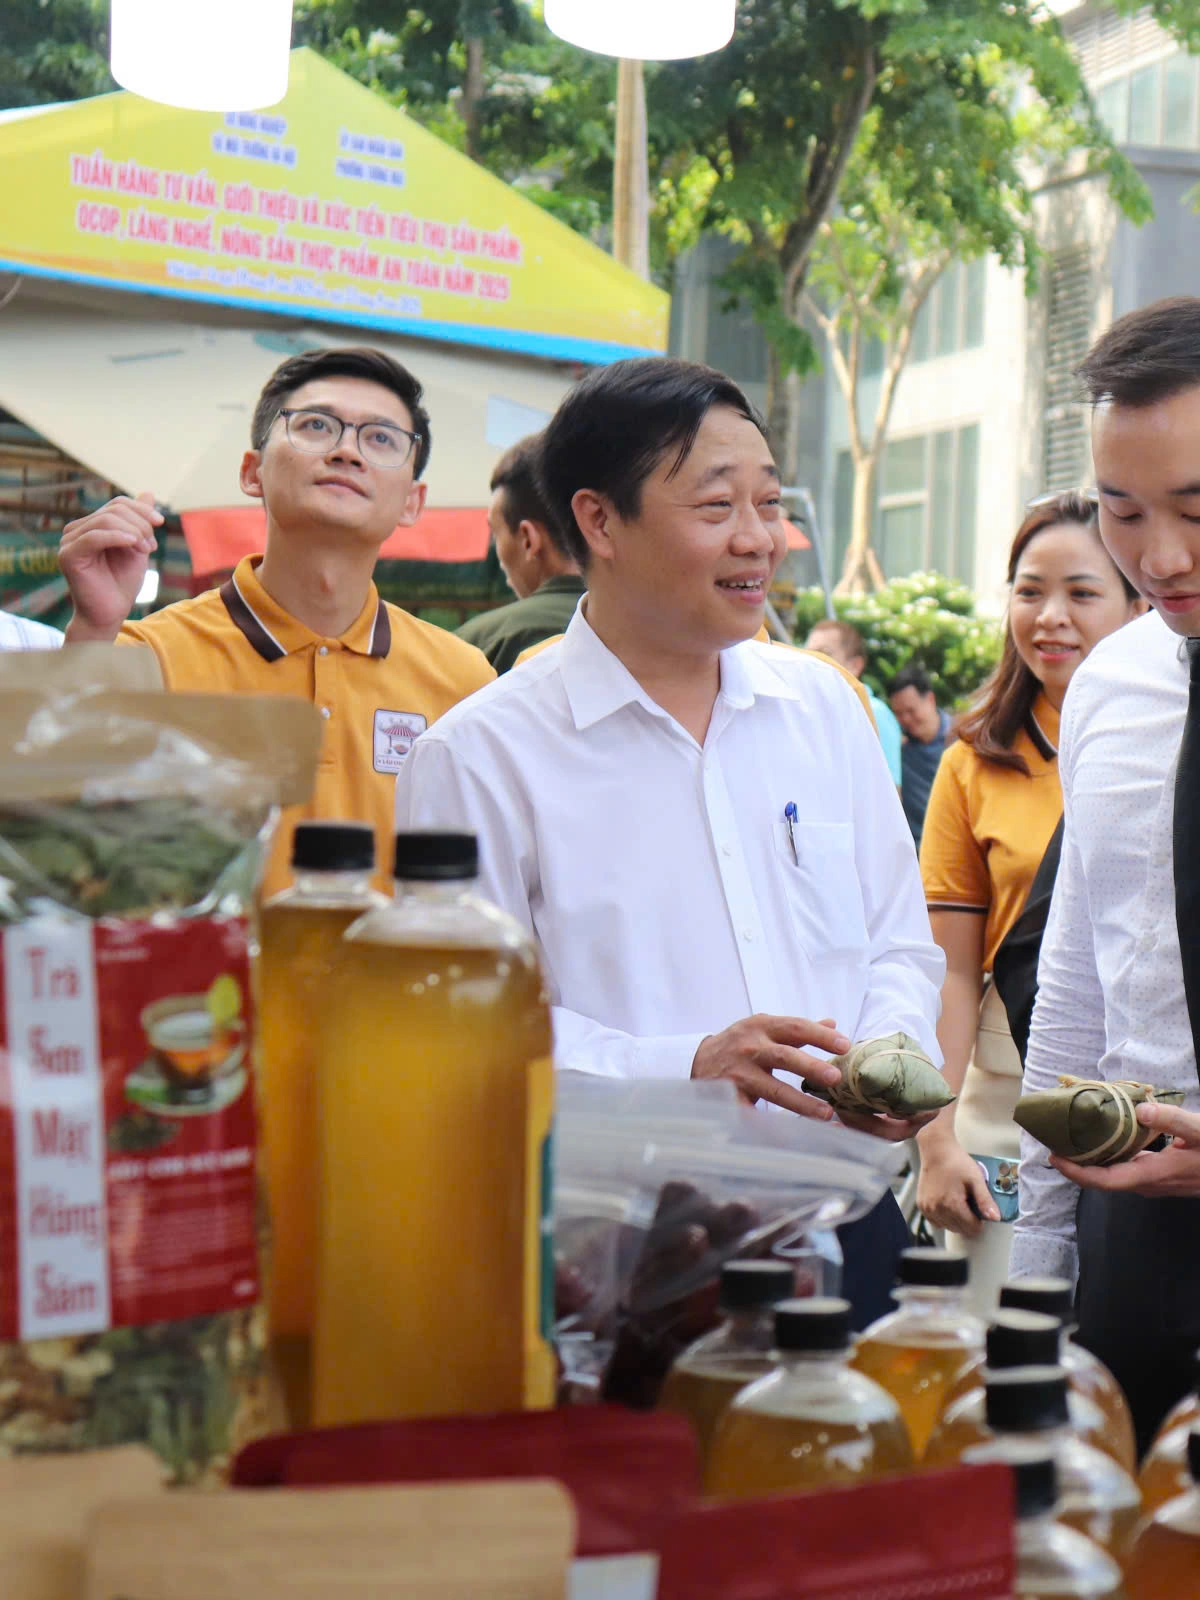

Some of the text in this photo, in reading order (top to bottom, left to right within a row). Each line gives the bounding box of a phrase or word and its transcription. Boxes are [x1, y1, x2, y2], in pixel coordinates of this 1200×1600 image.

[72, 149, 113, 188] TUẦN
[117, 160, 158, 197] HÀNG
[77, 201, 125, 239] OCOP,
[128, 207, 168, 243] LÀNG
[221, 224, 262, 258] NÔNG
[383, 256, 402, 282] AN
